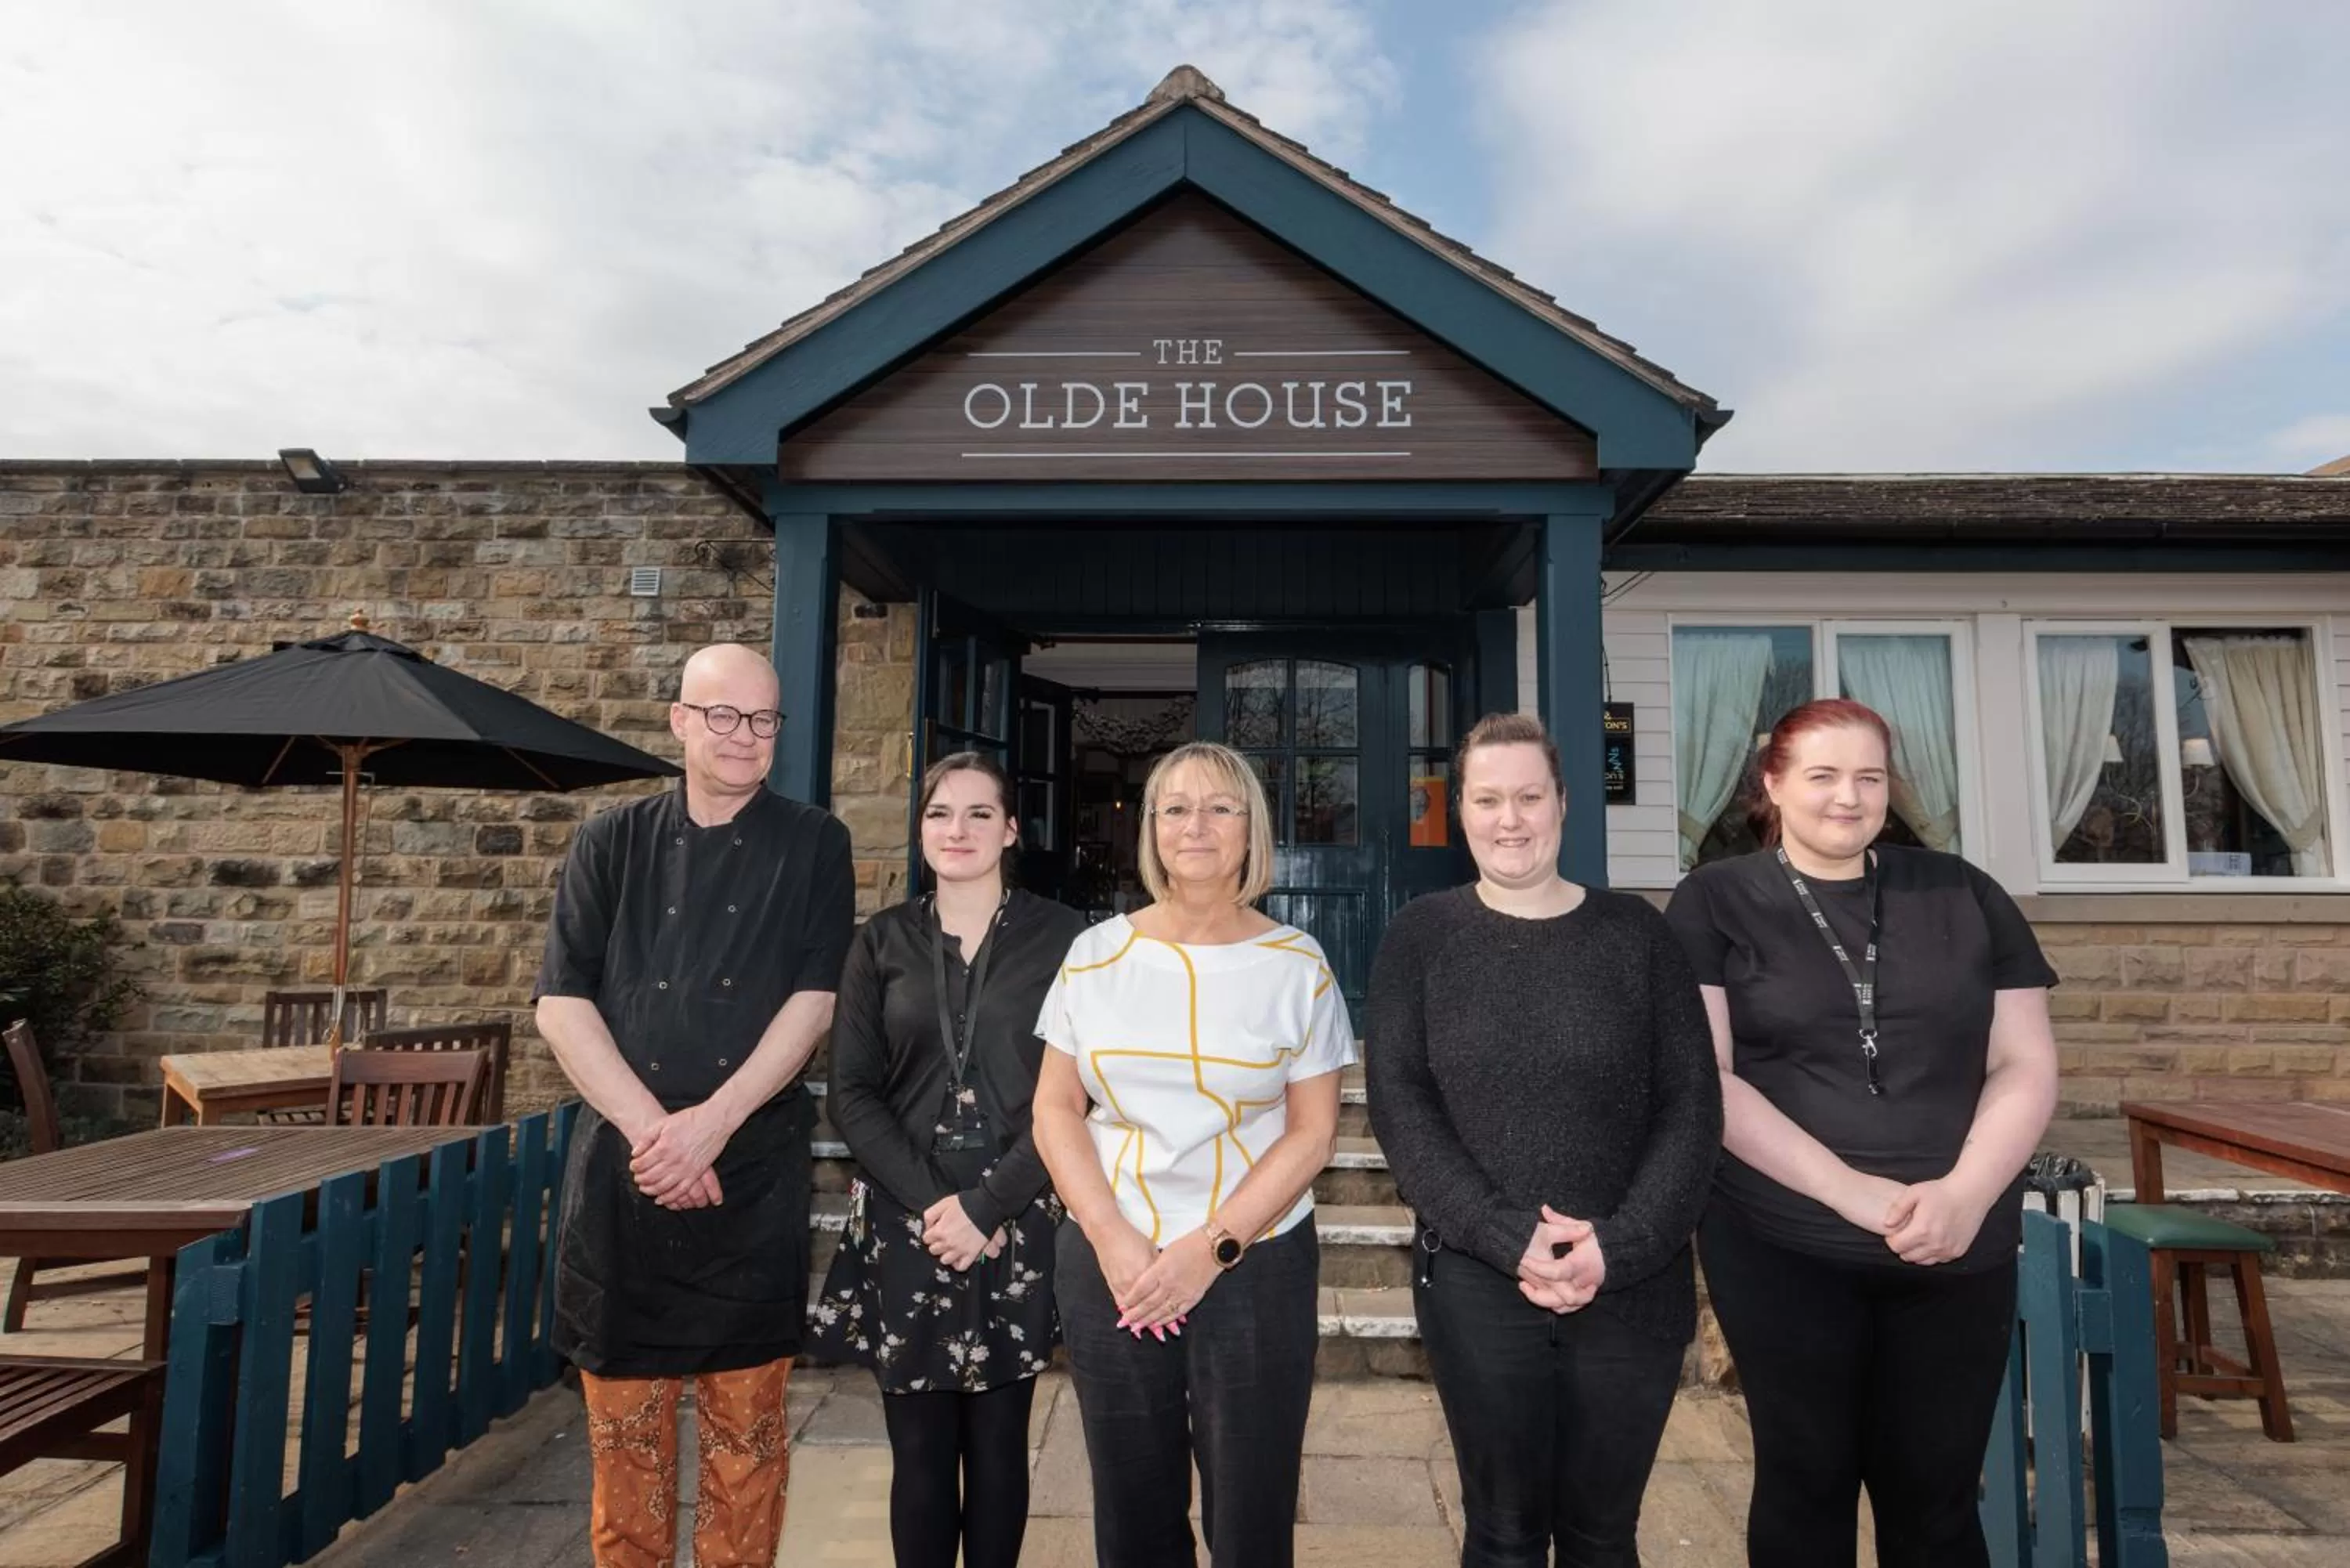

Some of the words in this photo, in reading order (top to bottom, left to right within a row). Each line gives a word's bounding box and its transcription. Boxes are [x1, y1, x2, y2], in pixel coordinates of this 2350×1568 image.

[1154, 340, 1222, 363] THE
[965, 383, 1148, 428] OLDE
[1175, 381, 1411, 428] HOUSE
